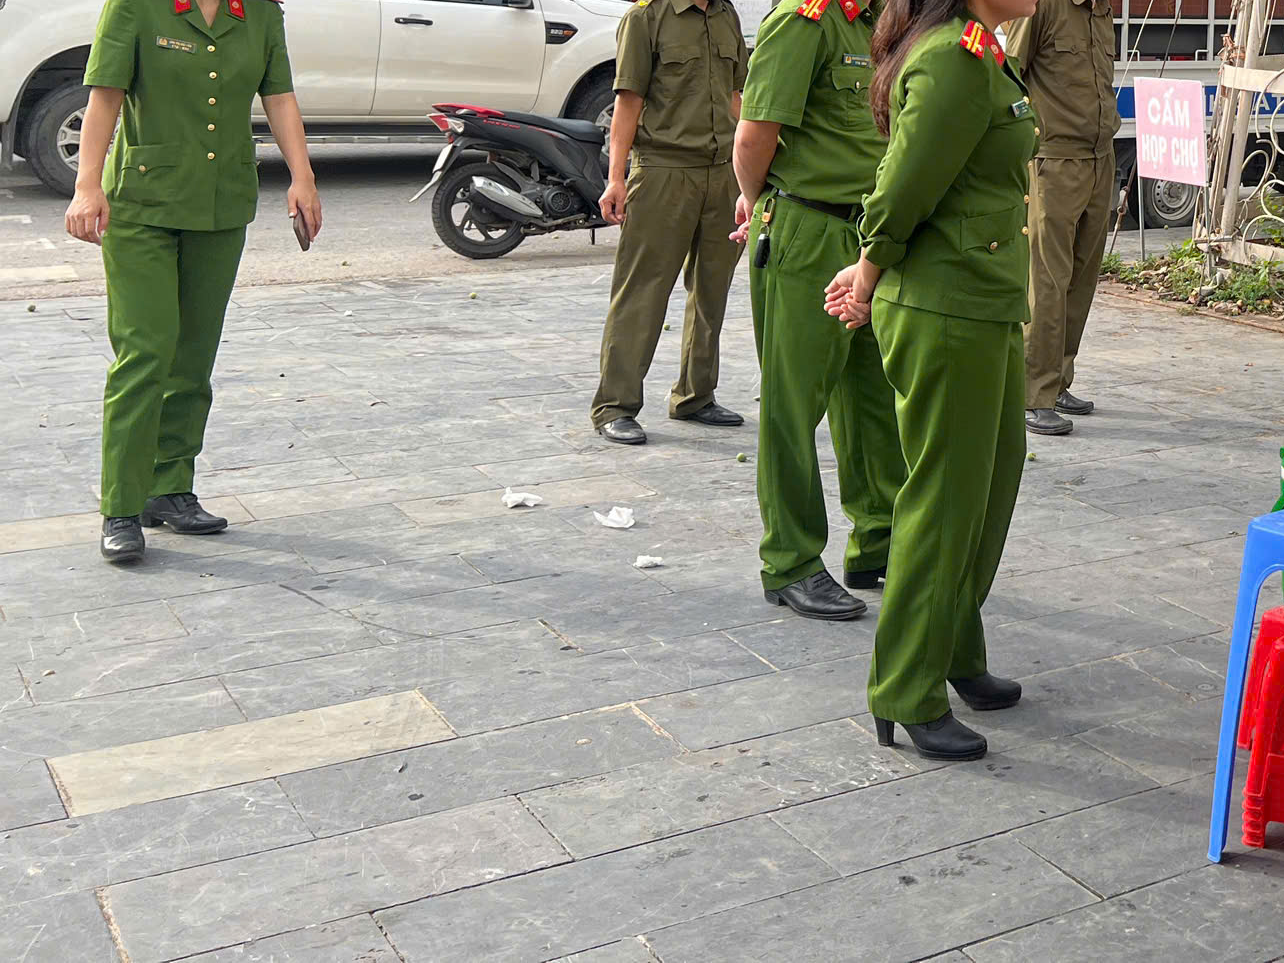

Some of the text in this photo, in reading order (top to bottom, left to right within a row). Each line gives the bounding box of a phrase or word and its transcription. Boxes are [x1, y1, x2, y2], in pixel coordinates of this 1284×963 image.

[1148, 87, 1190, 129] CẤM
[1142, 133, 1198, 174] HỌP CHỢ
